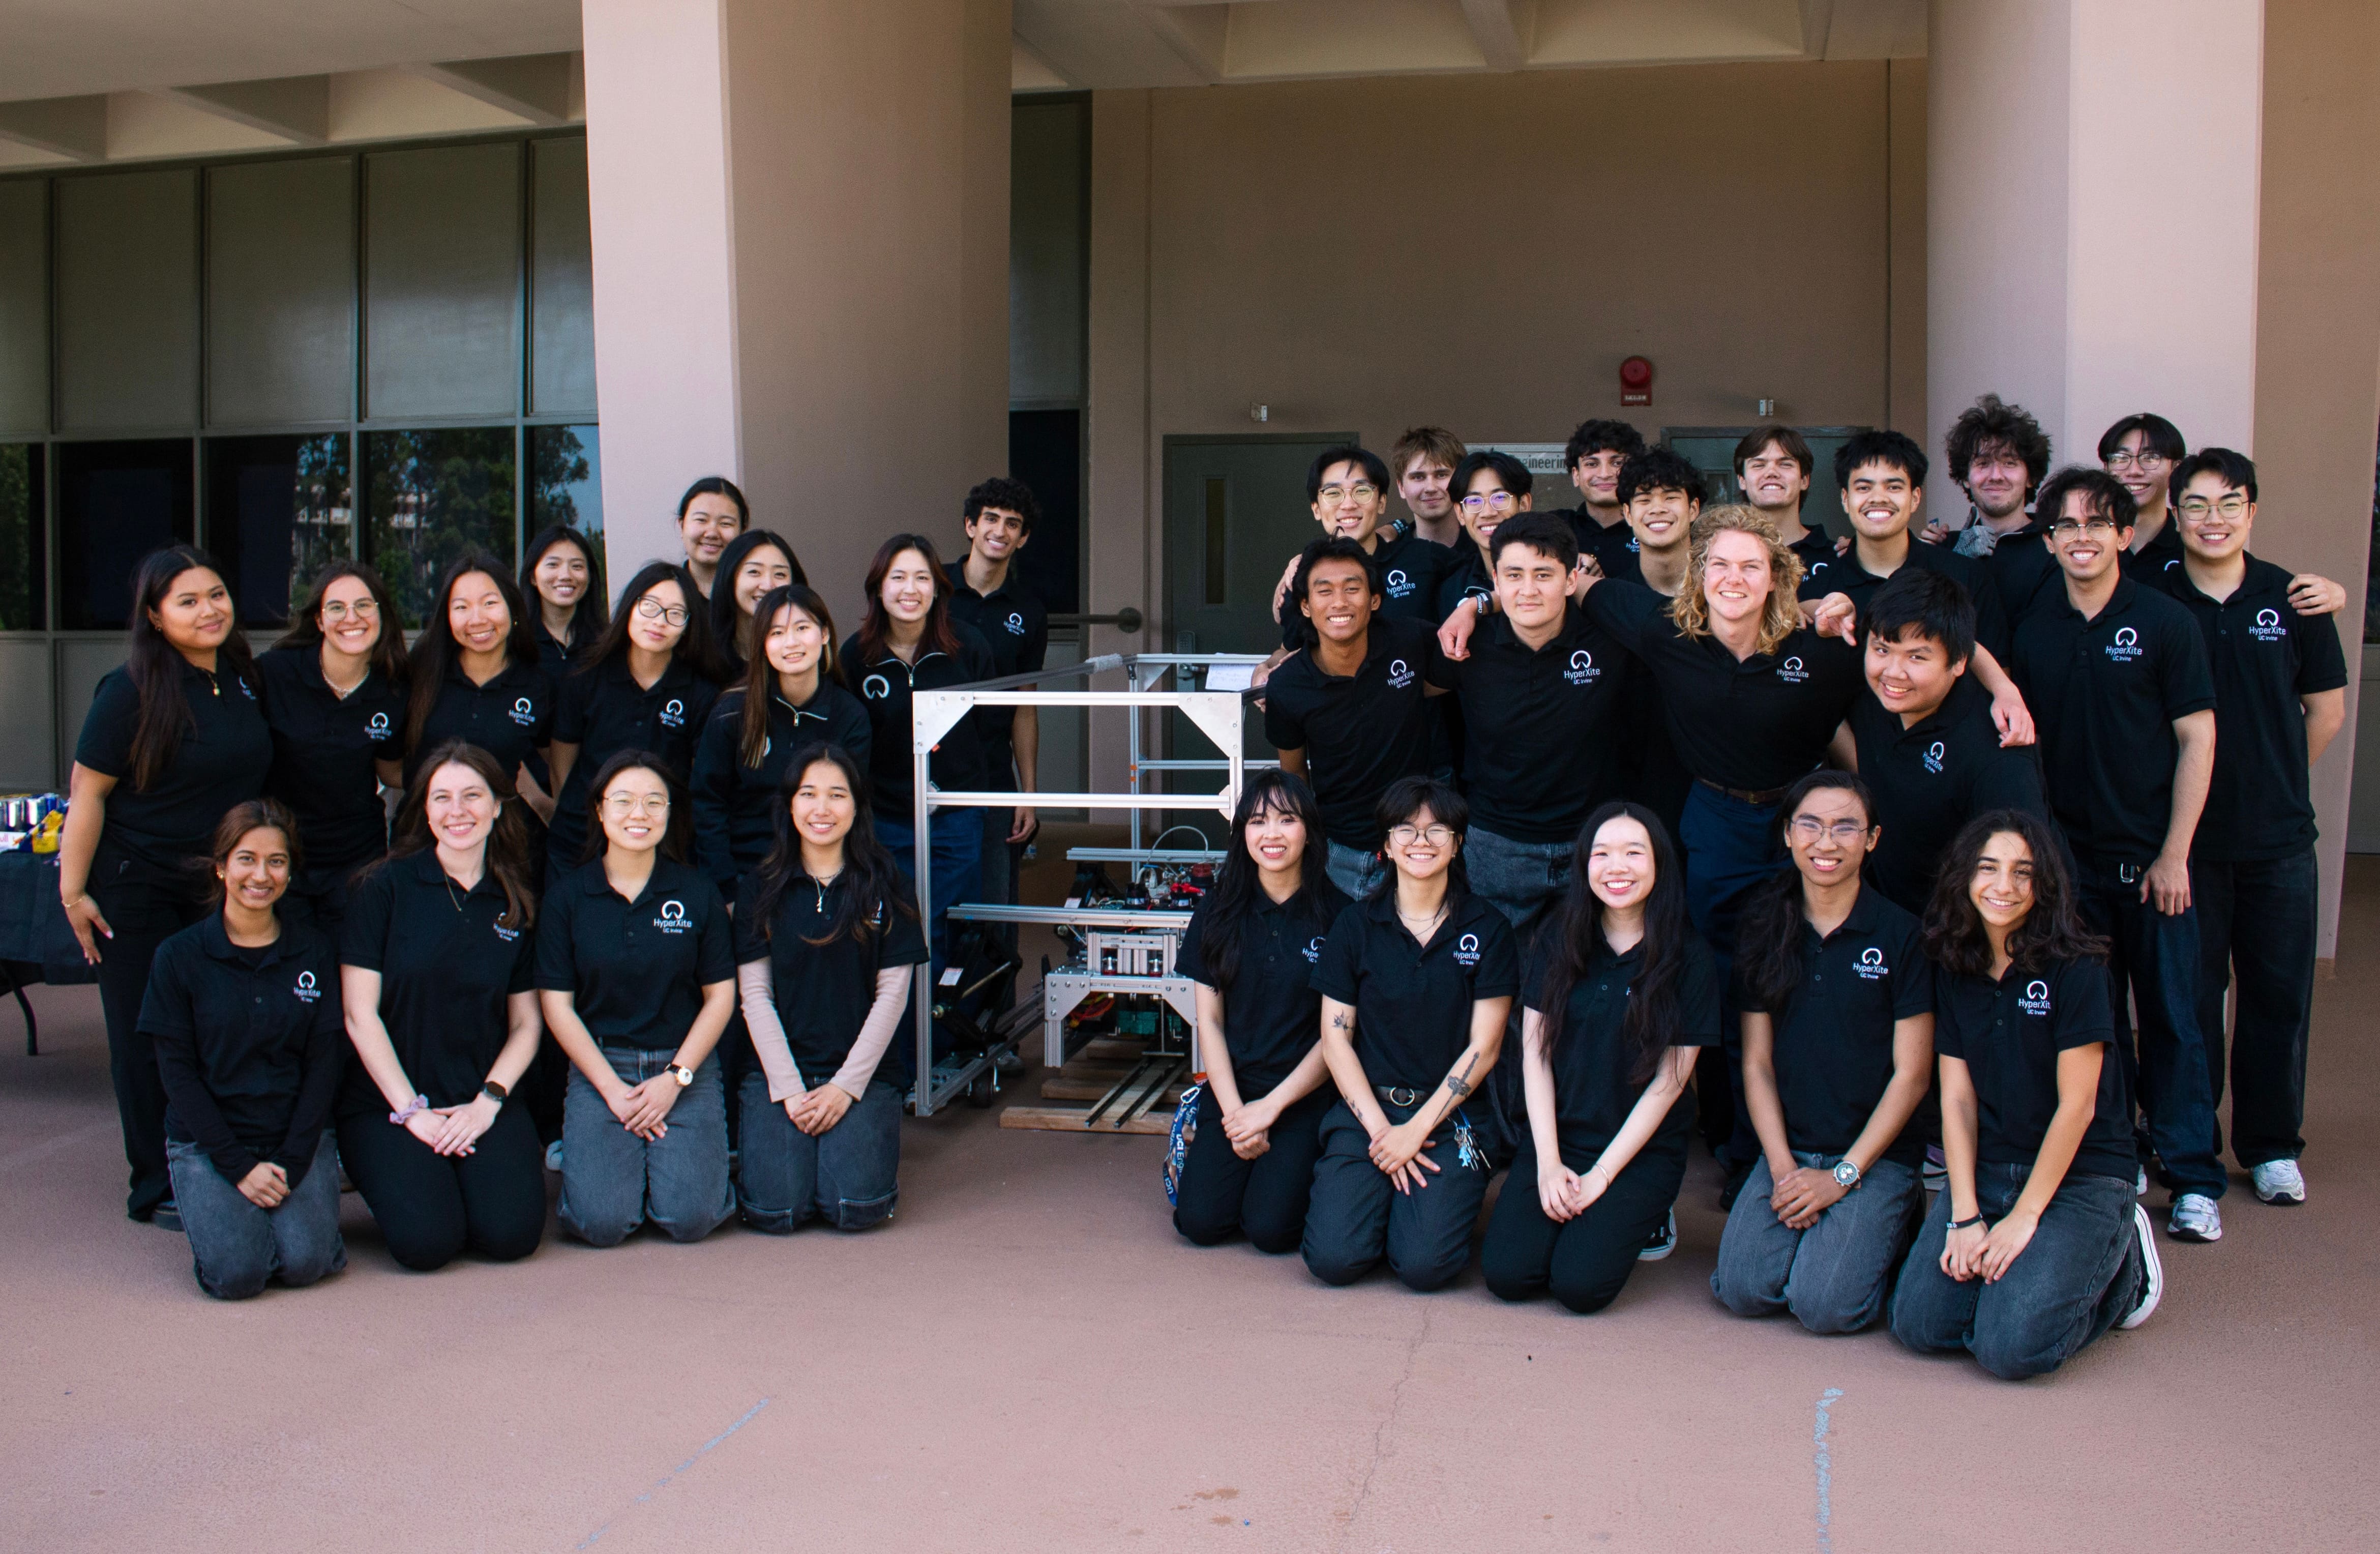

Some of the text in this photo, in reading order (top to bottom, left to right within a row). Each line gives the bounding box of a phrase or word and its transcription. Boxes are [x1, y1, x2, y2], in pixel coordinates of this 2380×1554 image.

[2249, 626, 2286, 636] HyperXite
[2106, 646, 2143, 656] HyperXite
[1387, 670, 1415, 686] HyperXite
[1564, 668, 1601, 680] HyperXite
[1777, 669, 1809, 678] HyperXite
[653, 918, 692, 928] HyperXite
[1853, 962, 1889, 974] HyperXite
[2018, 999, 2050, 1009] HyperXit
[1176, 1134, 1184, 1150] UCI
[1165, 1178, 1174, 1195] UCI
